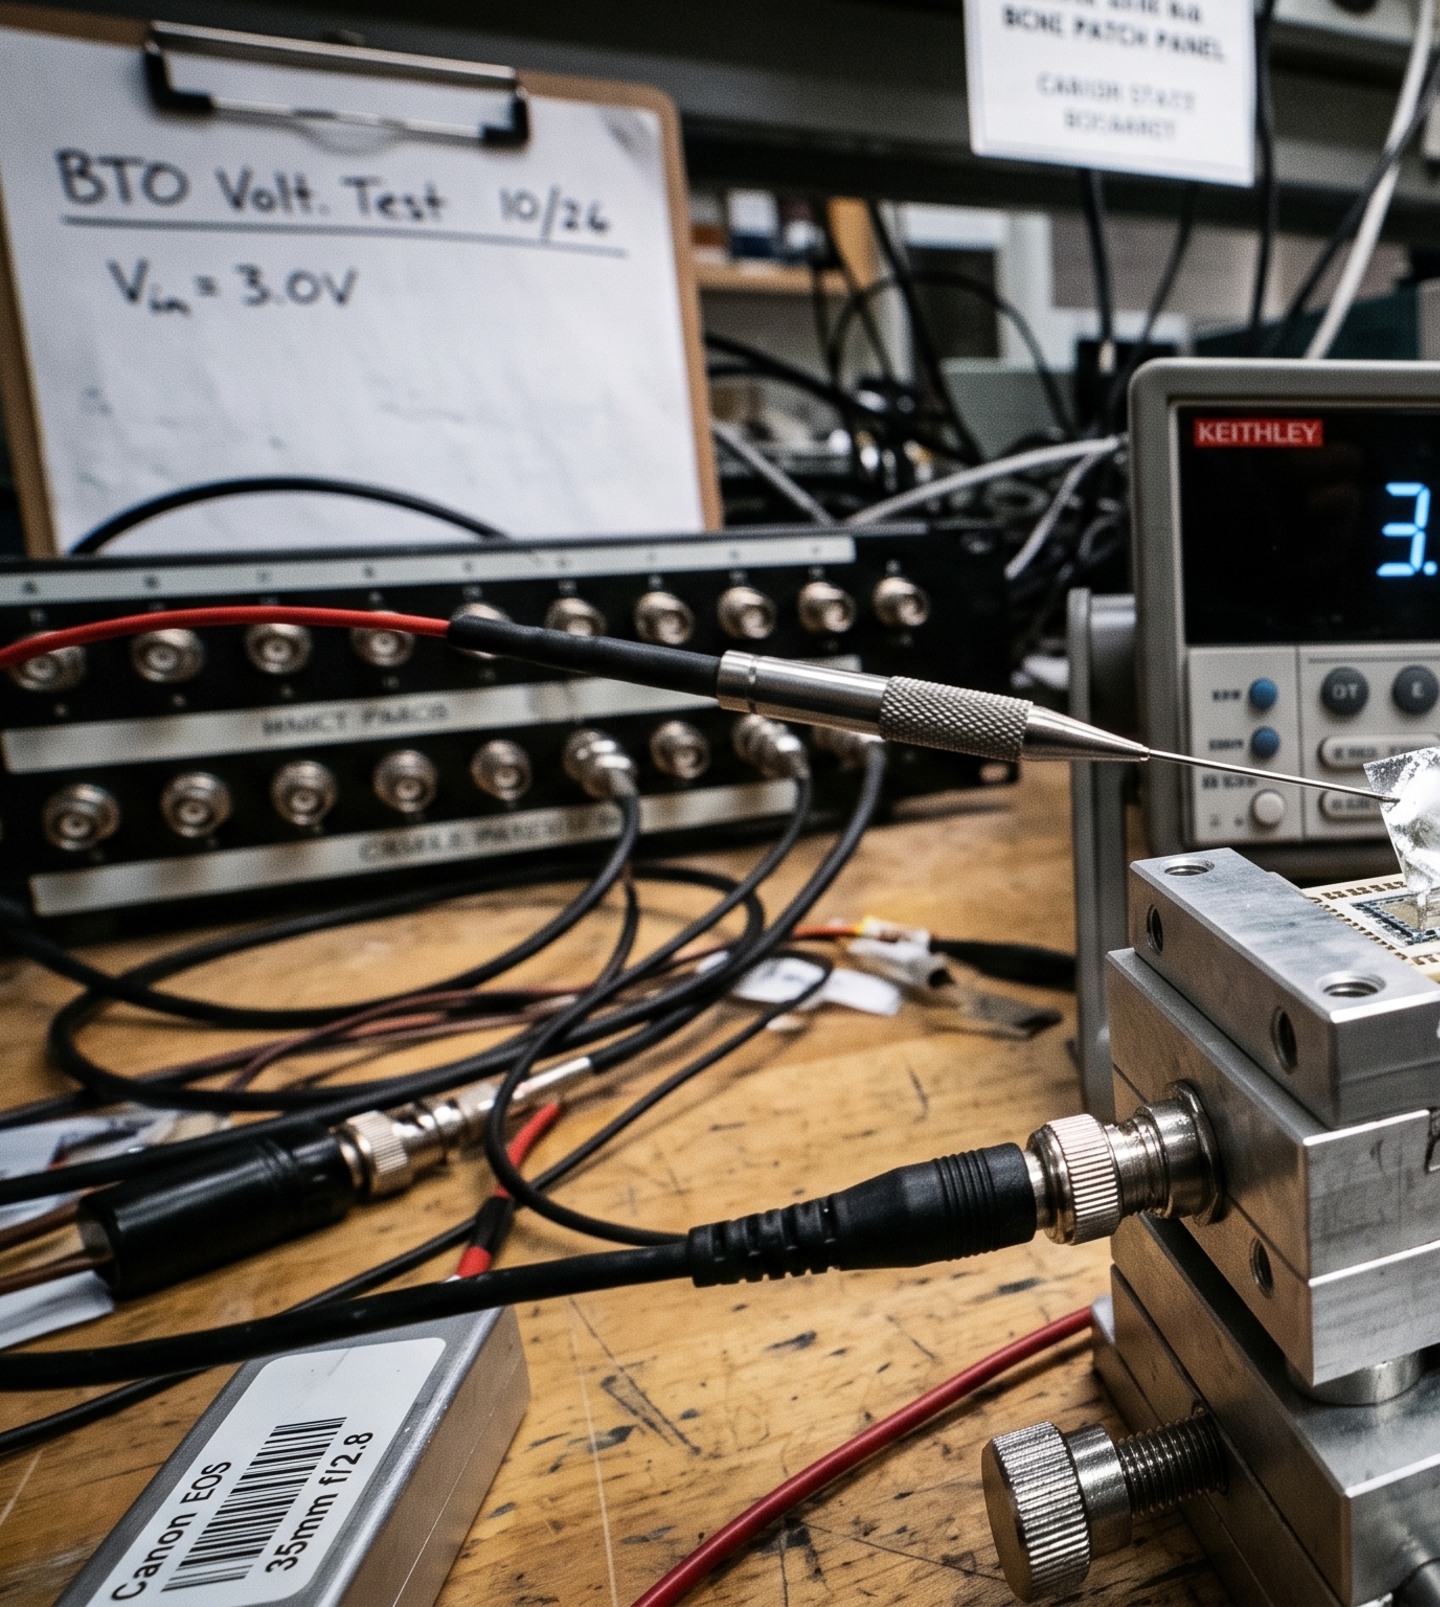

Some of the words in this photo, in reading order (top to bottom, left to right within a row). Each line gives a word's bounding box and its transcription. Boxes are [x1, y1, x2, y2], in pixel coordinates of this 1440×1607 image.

[57, 150, 191, 205] BTO
[217, 166, 331, 217] Volt.
[341, 175, 448, 221] Test
[1198, 421, 1320, 444] KEITHLEY
[110, 1510, 199, 1602] Canon
[180, 1461, 233, 1505] EOS
[265, 1490, 341, 1575] 35mm
[319, 1430, 375, 1491] f/2.8
